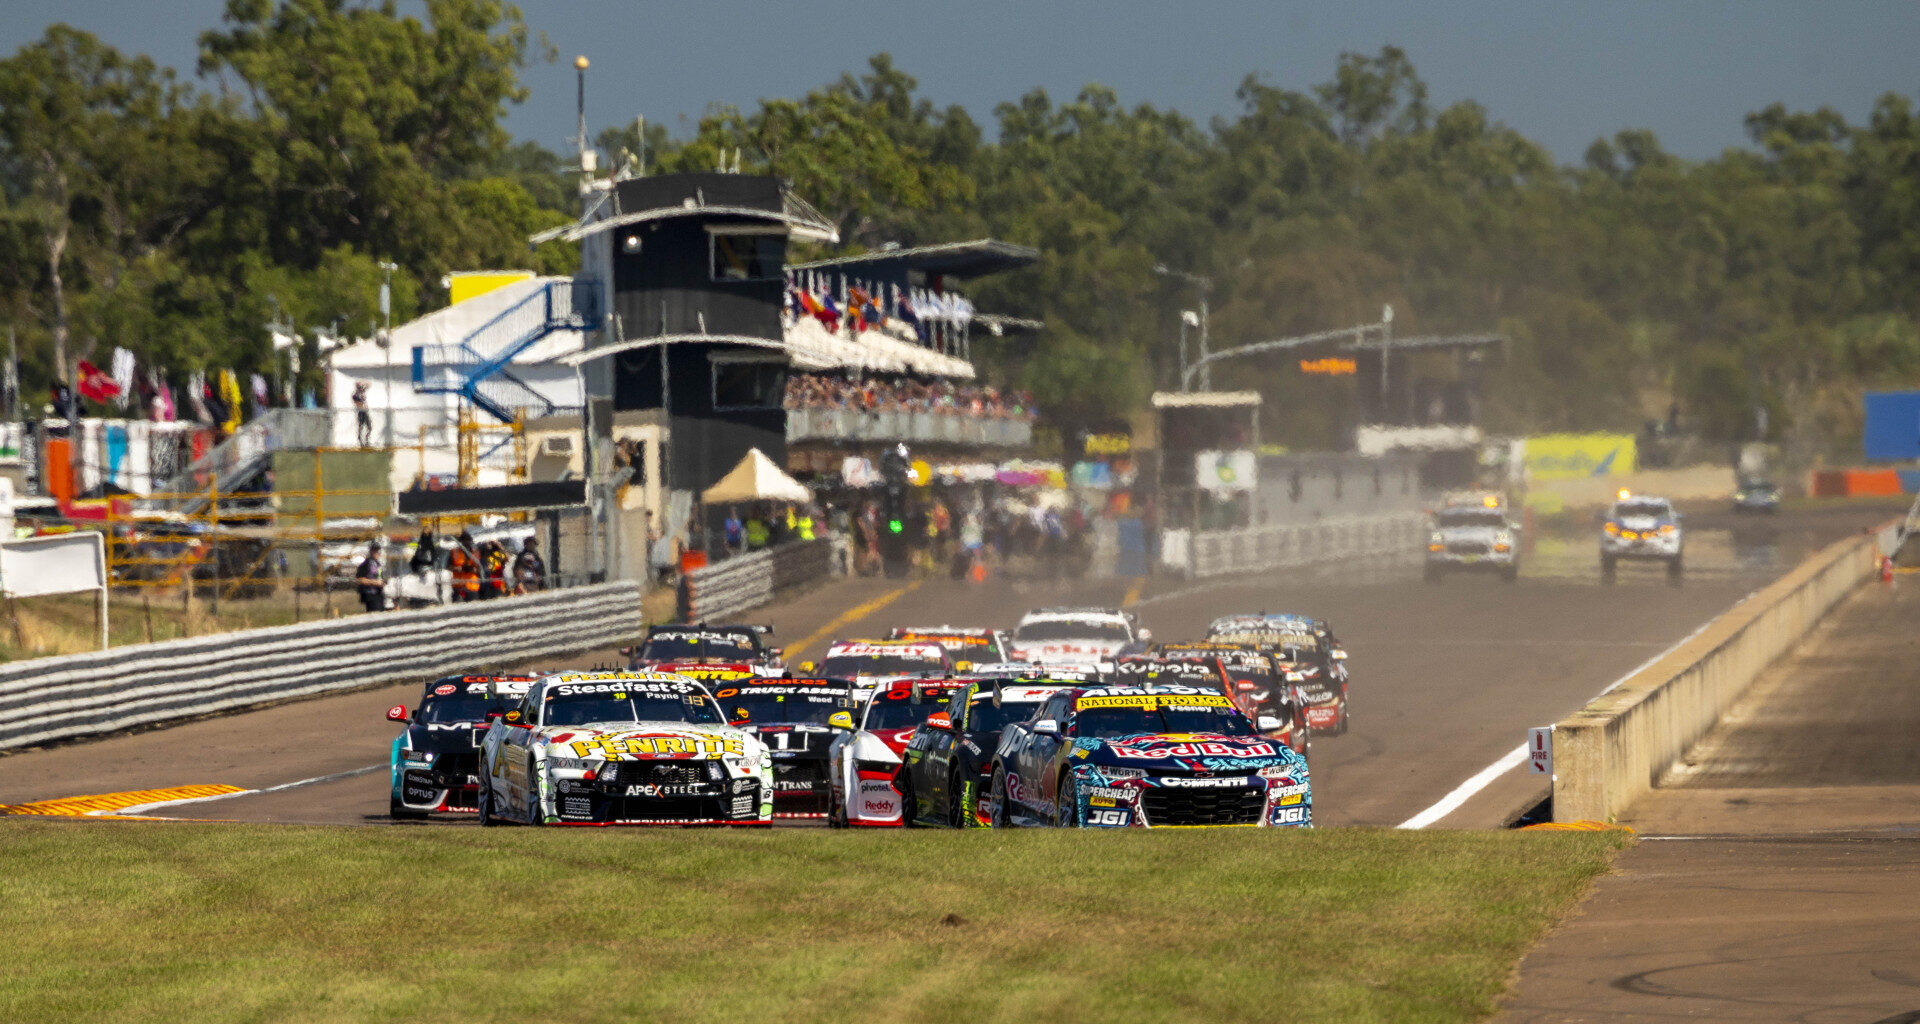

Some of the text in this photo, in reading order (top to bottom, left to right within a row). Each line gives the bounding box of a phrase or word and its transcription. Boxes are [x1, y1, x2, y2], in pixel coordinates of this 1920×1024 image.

[557, 683, 670, 696] Steadfast
[740, 687, 797, 695] TRUCK
[1081, 686, 1222, 697] AMPOL
[647, 692, 679, 700] Payne
[1080, 695, 1230, 707] NATIONAL STORAGE
[774, 734, 788, 749] 1
[569, 737, 745, 759] PENRITE
[1111, 743, 1275, 759] Red Bull
[1531, 751, 1547, 760] FIRE
[780, 781, 812, 790] TRANS
[1160, 777, 1249, 788] COMPLETE
[408, 787, 434, 798] OPTUS
[625, 783, 664, 798] APEX
[1079, 785, 1138, 801] SUPERCHEAP
[865, 801, 894, 812] Reddy
[1092, 797, 1115, 806] AUTO
[1087, 810, 1129, 826] JGI
[1274, 807, 1304, 824] JGI
